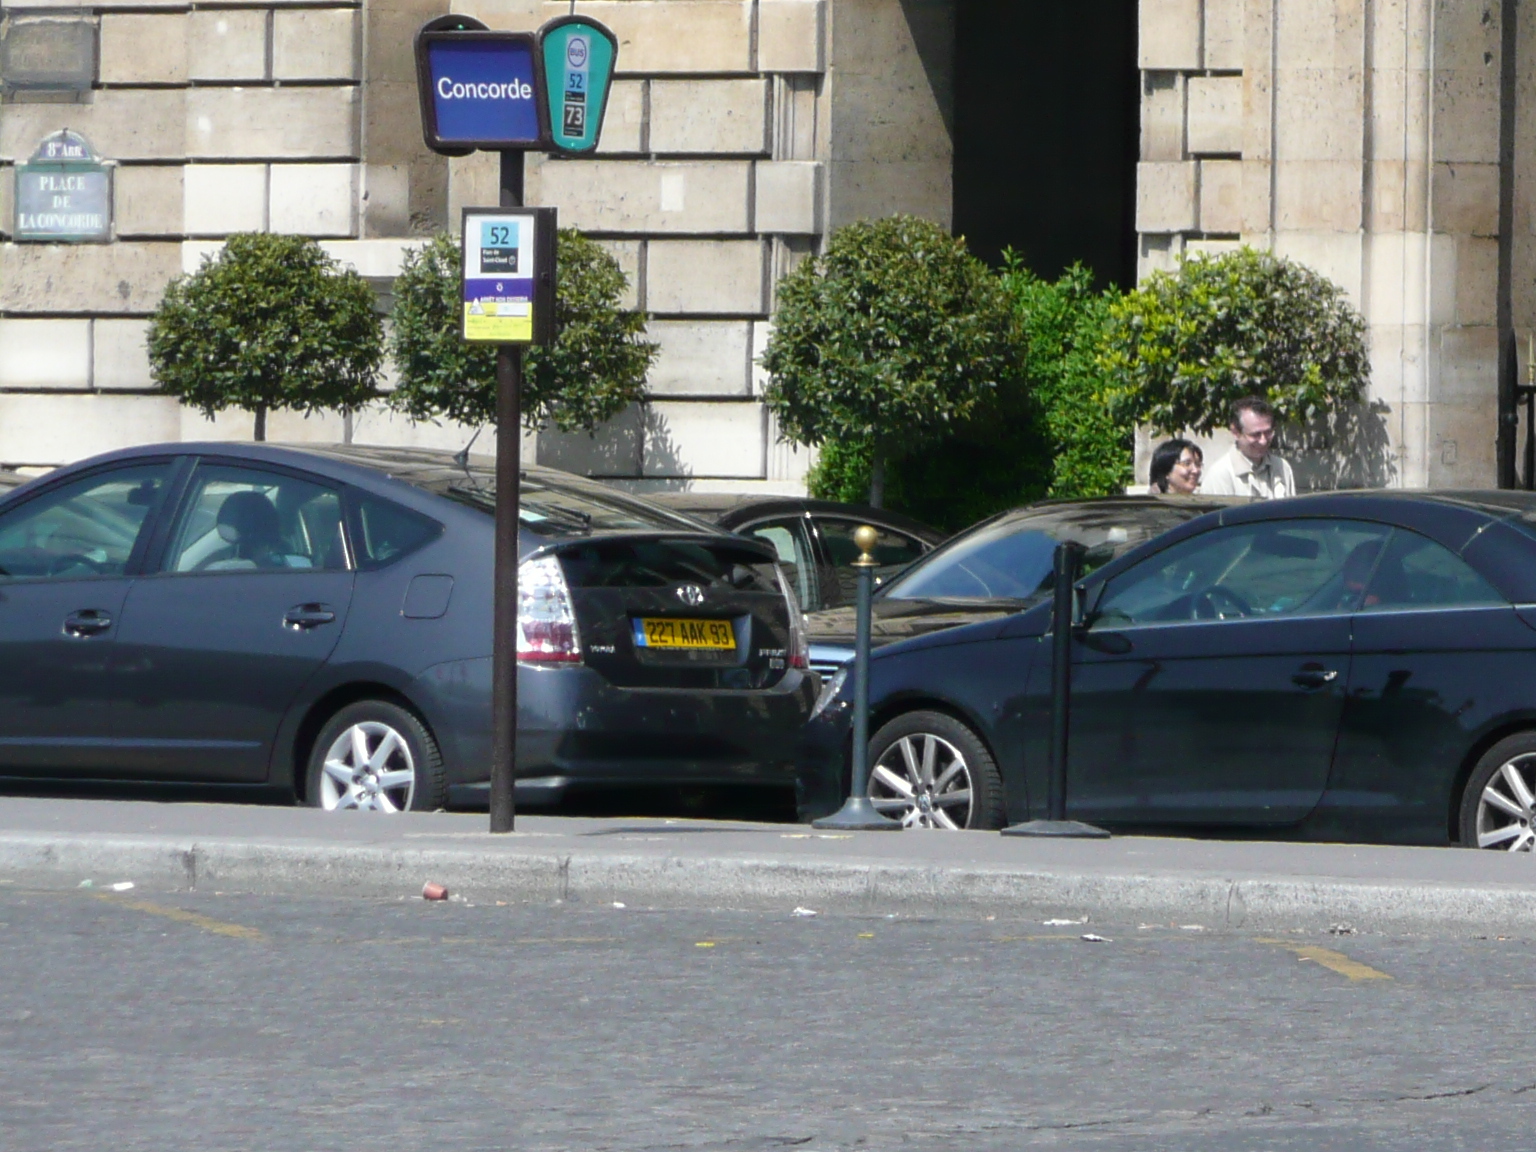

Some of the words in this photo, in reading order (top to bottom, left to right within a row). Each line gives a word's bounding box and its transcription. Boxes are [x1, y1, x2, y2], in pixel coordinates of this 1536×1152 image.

[437, 76, 533, 100] Concorde
[569, 73, 583, 89] 52
[566, 106, 583, 126] 73
[39, 176, 85, 191] PLACE
[53, 195, 71, 209] DE
[37, 213, 102, 229] CONCORDE
[490, 226, 509, 245] 52
[646, 621, 675, 644] 227
[680, 622, 706, 644] AAK
[710, 623, 730, 645] 93
